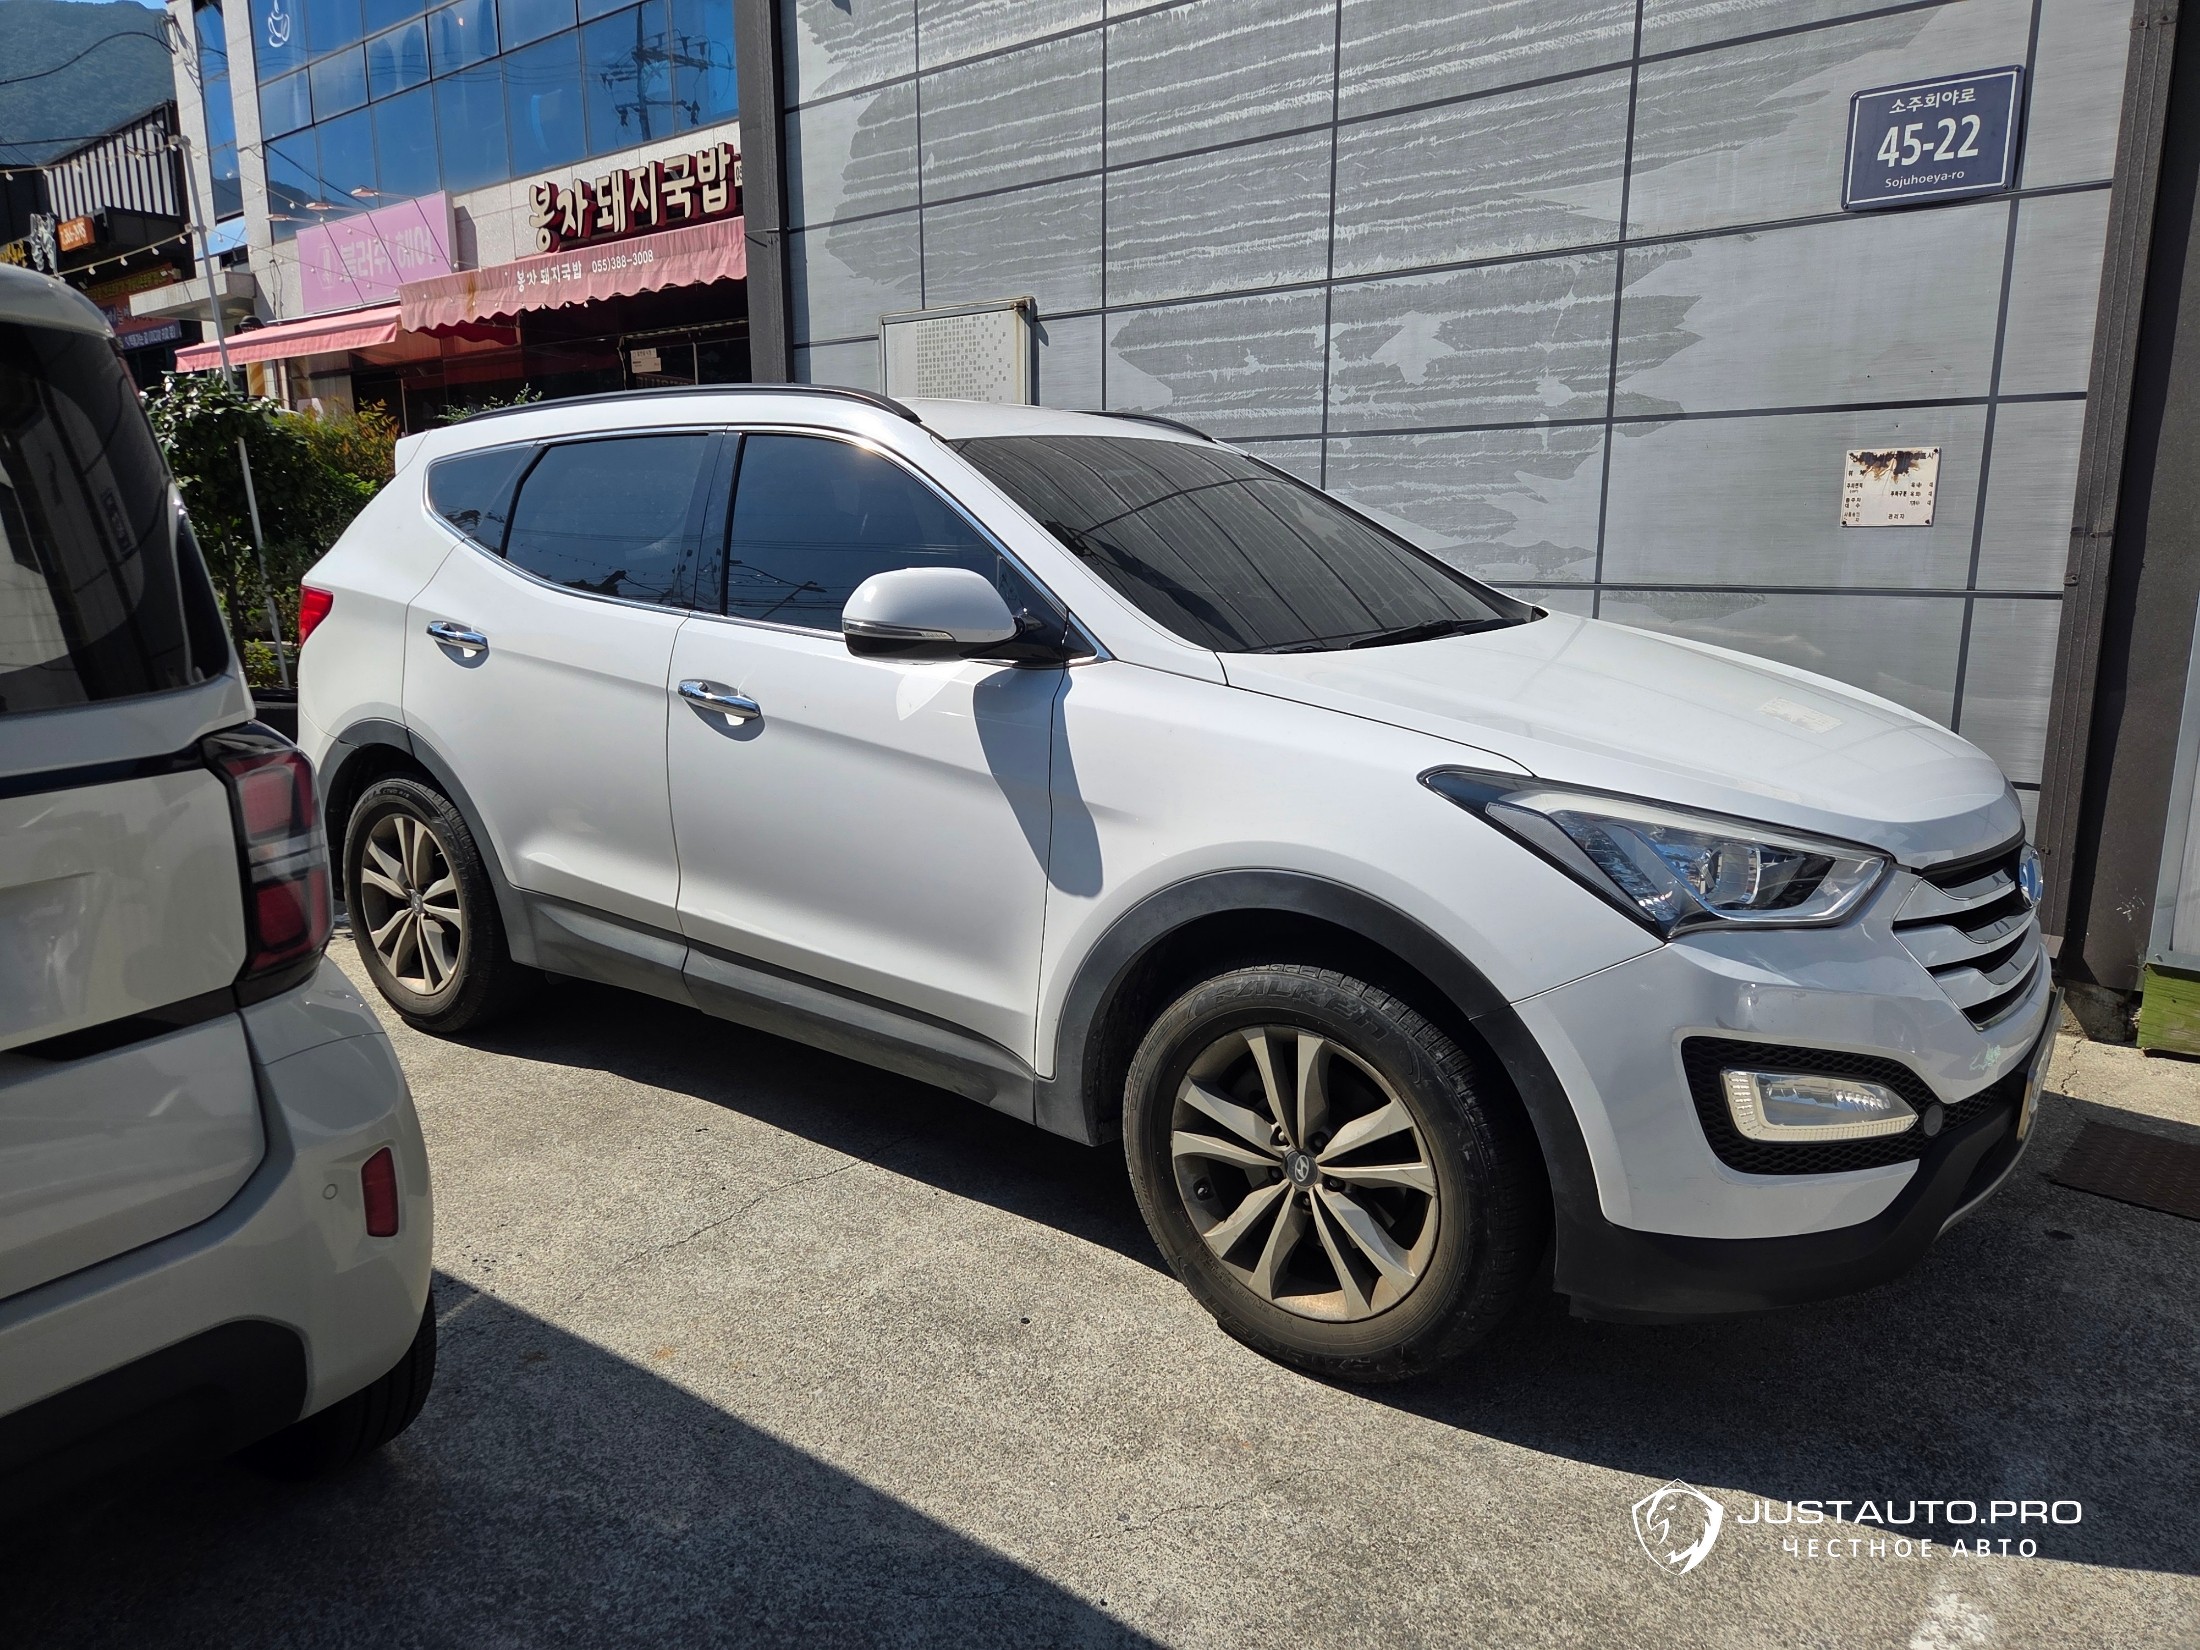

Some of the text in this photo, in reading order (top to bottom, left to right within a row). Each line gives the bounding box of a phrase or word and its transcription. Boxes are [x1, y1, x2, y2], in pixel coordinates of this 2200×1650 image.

[1889, 87, 1976, 114] 소주회야로
[1877, 114, 1981, 168] 45-22
[1884, 170, 1965, 189] Sojuhoeya-ro
[592, 249, 654, 273] 055)388-3008
